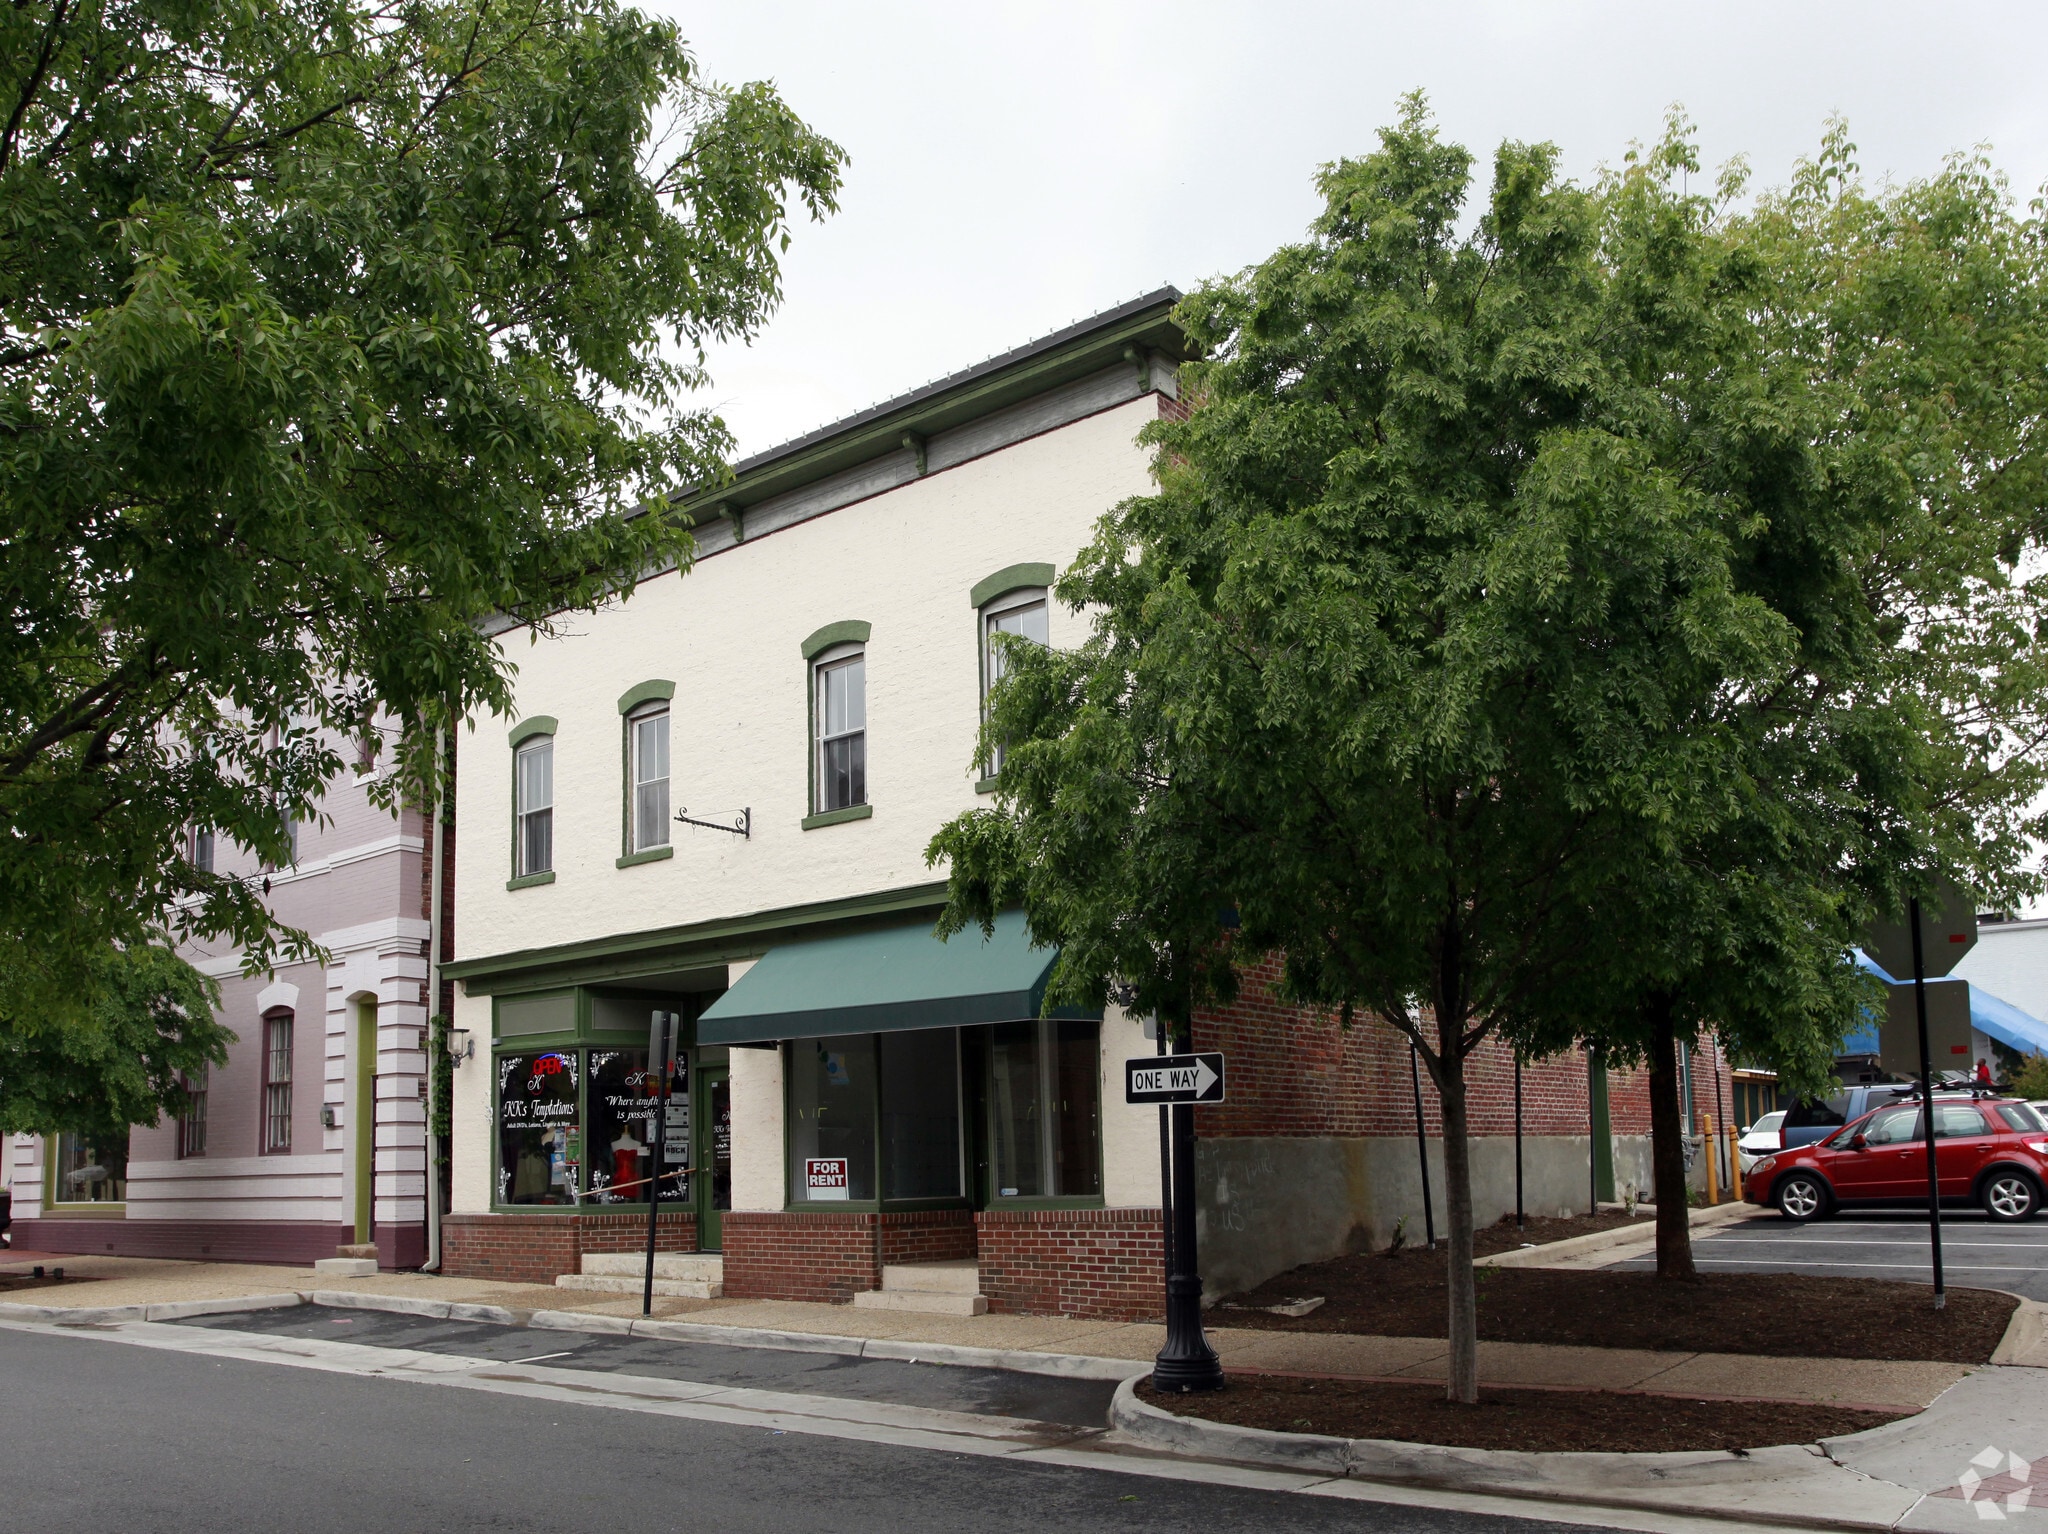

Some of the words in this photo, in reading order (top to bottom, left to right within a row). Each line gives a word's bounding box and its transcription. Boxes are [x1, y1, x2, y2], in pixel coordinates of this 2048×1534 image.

[533, 1058, 562, 1074] OPEN
[1135, 1071, 1162, 1089] ONE
[1170, 1069, 1200, 1088] WAY
[636, 1096, 671, 1109] anythg
[531, 1099, 574, 1122] Temptations
[813, 1162, 839, 1174] FOR
[809, 1174, 844, 1186] RENT
